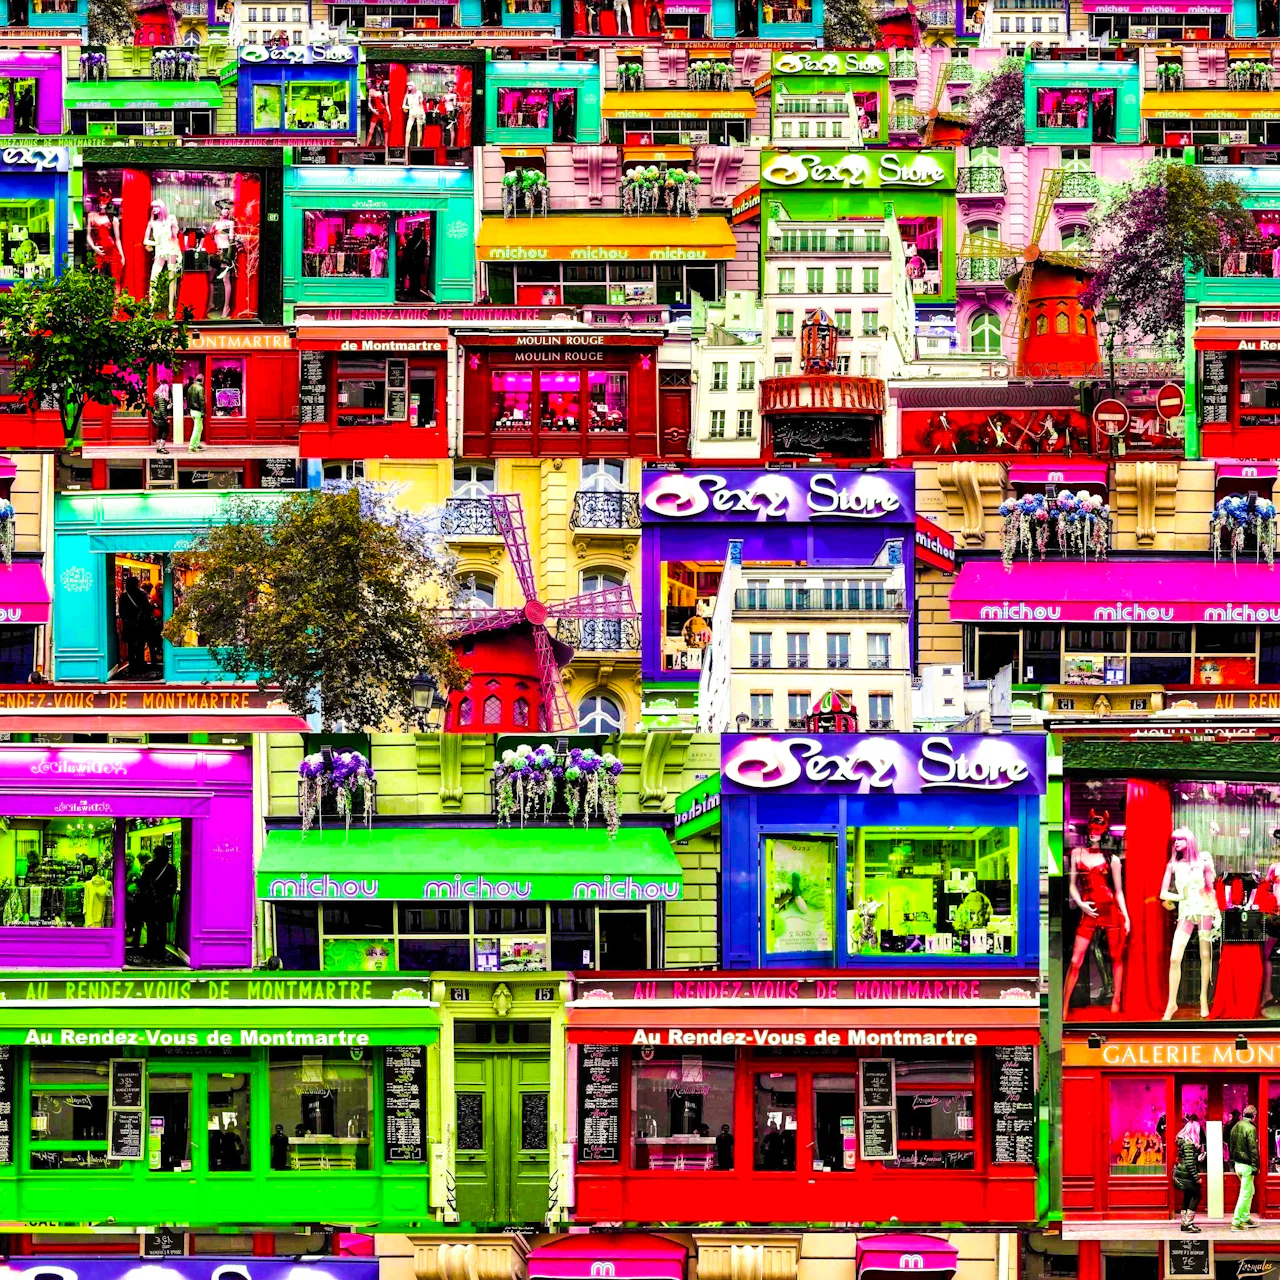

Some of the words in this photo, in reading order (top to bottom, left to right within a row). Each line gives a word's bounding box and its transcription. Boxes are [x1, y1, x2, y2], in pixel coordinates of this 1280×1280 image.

[490, 246, 547, 258] michou
[571, 246, 628, 259] michou
[650, 247, 706, 259] michou
[644, 475, 787, 516] Sexy
[808, 475, 900, 518] Store
[915, 531, 955, 560] michou
[981, 602, 1061, 619] michou
[1094, 602, 1174, 622] michou
[1214, 692, 1234, 709] AU
[724, 737, 896, 788] Sexy
[918, 735, 1028, 789] Store
[270, 873, 379, 898] michou
[424, 874, 532, 899] michou
[573, 875, 682, 901] michou
[25, 1028, 54, 1046] Au
[60, 1028, 200, 1046] Rendez-Vous
[206, 1028, 233, 1046] de
[240, 1028, 369, 1046] Montmartre
[1103, 1045, 1202, 1065] GALERIE
